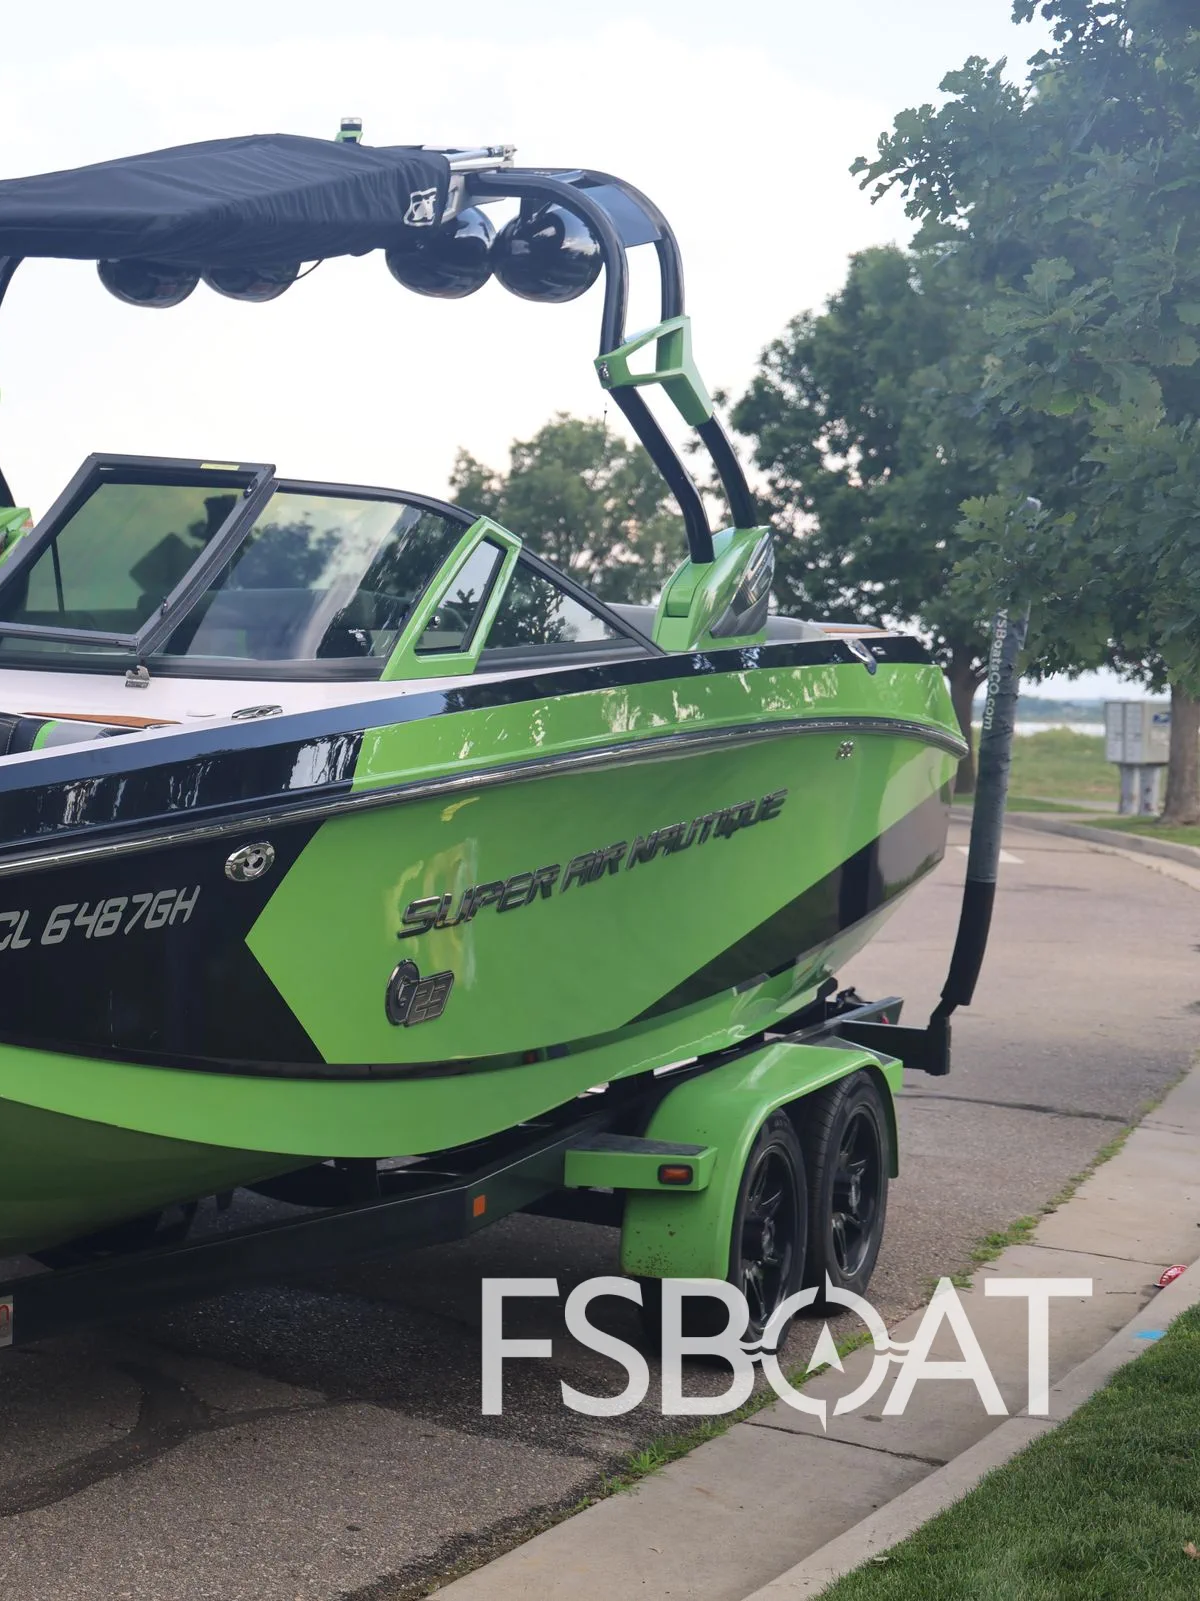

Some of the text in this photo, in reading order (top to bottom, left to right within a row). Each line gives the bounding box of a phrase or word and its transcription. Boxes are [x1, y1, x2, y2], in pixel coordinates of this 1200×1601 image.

[40, 885, 200, 945] 6487GH
[397, 788, 788, 939] SUPER AIR NAUTIQUE
